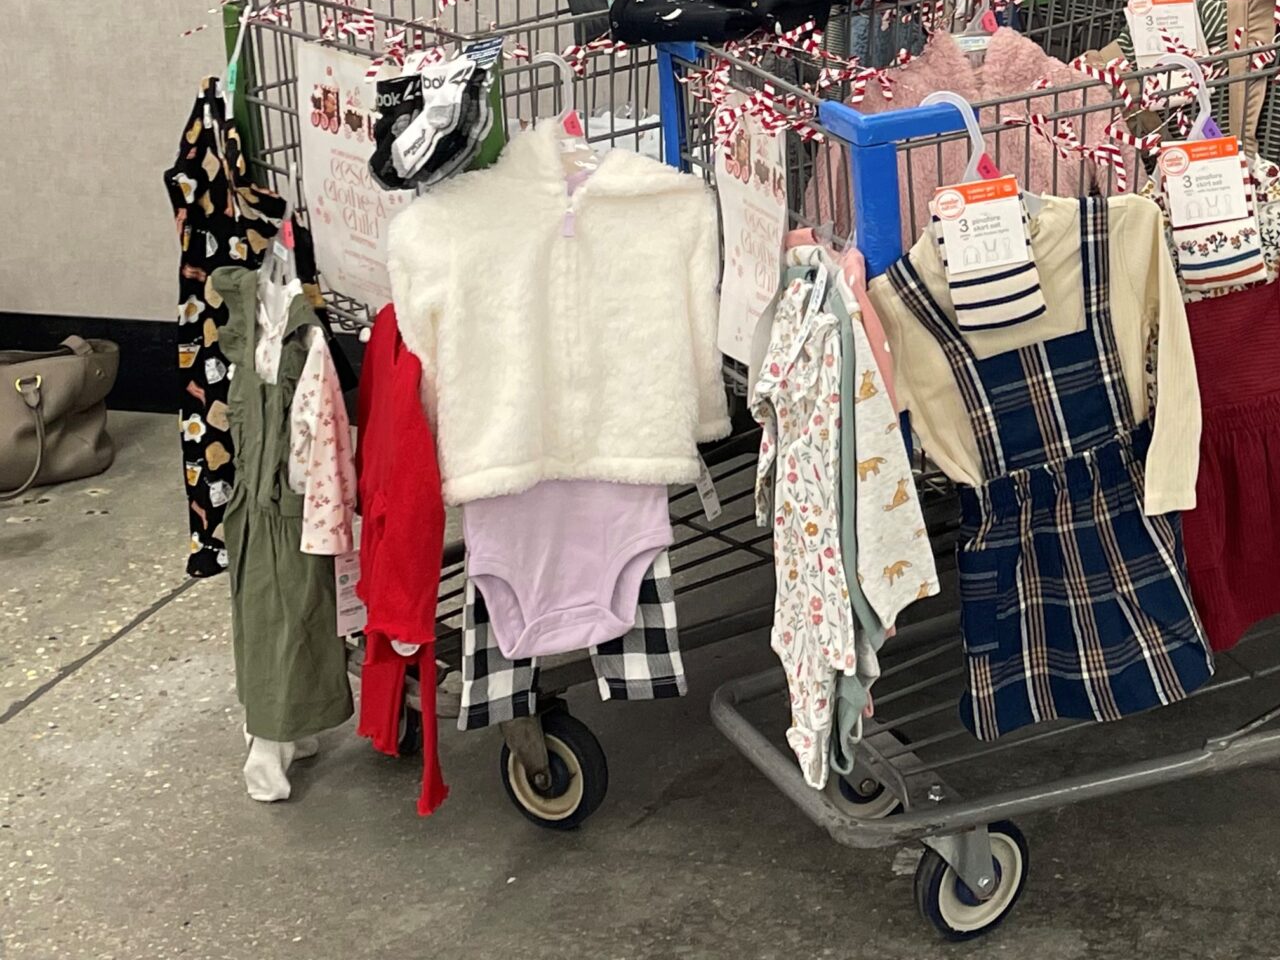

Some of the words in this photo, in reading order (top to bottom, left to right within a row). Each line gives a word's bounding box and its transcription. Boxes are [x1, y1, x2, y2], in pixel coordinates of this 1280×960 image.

[1146, 15, 1154, 26] 3
[1182, 175, 1192, 188] 3
[958, 219, 969, 233] 3
